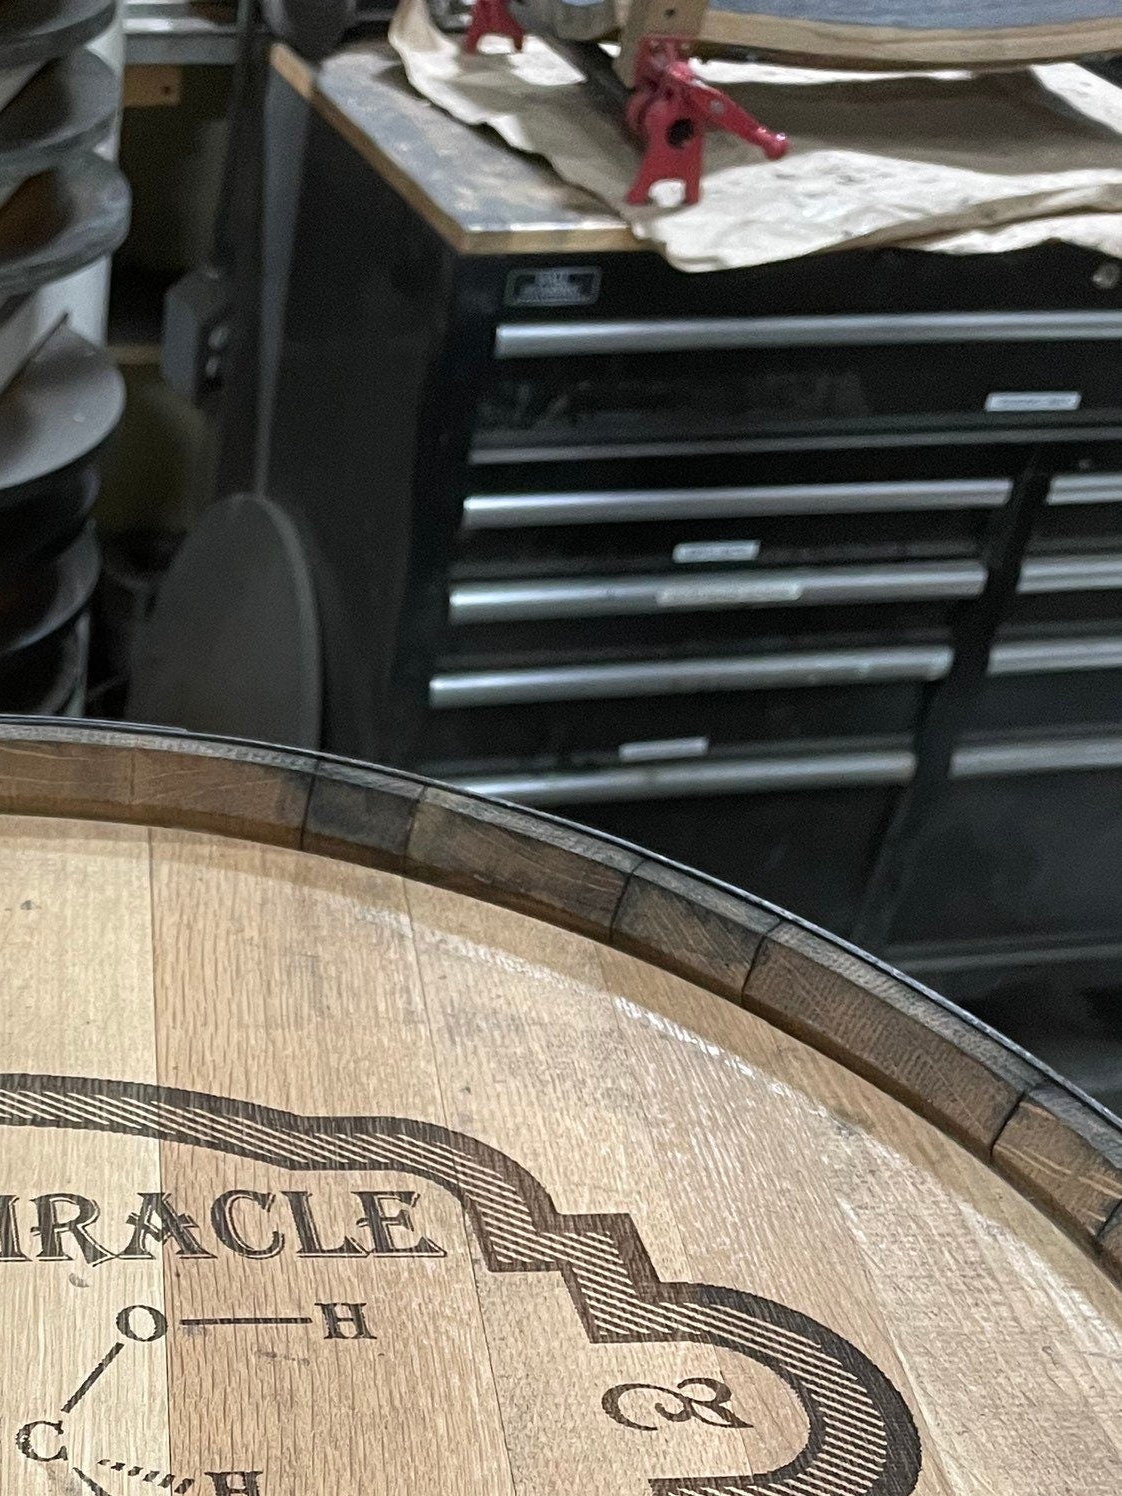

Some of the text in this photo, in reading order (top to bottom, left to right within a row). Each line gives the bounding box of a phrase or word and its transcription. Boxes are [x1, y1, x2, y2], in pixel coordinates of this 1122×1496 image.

[115, 1302, 377, 1344] O H
[15, 1419, 68, 1463] C
